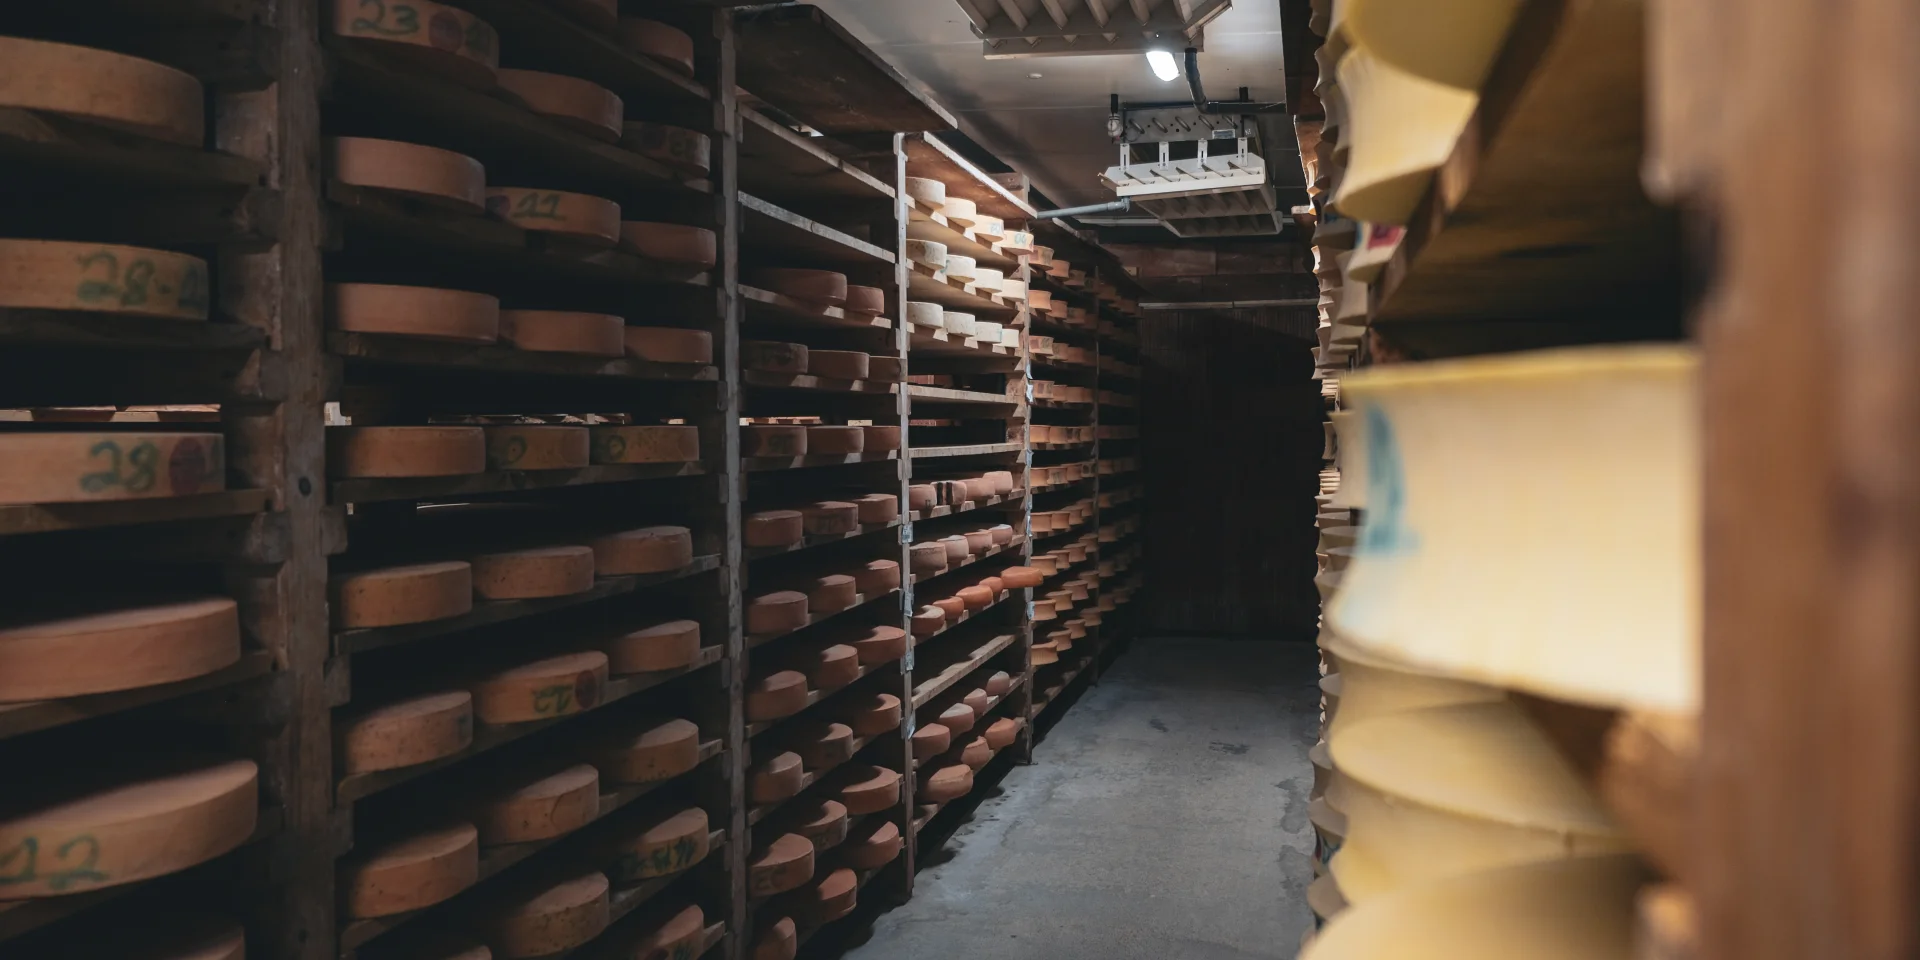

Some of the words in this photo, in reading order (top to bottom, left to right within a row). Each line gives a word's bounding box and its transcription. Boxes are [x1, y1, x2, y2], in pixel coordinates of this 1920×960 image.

[351, 0, 419, 36] 23
[511, 191, 568, 223] 11
[77, 438, 160, 494] 28
[0, 830, 111, 891] 12
